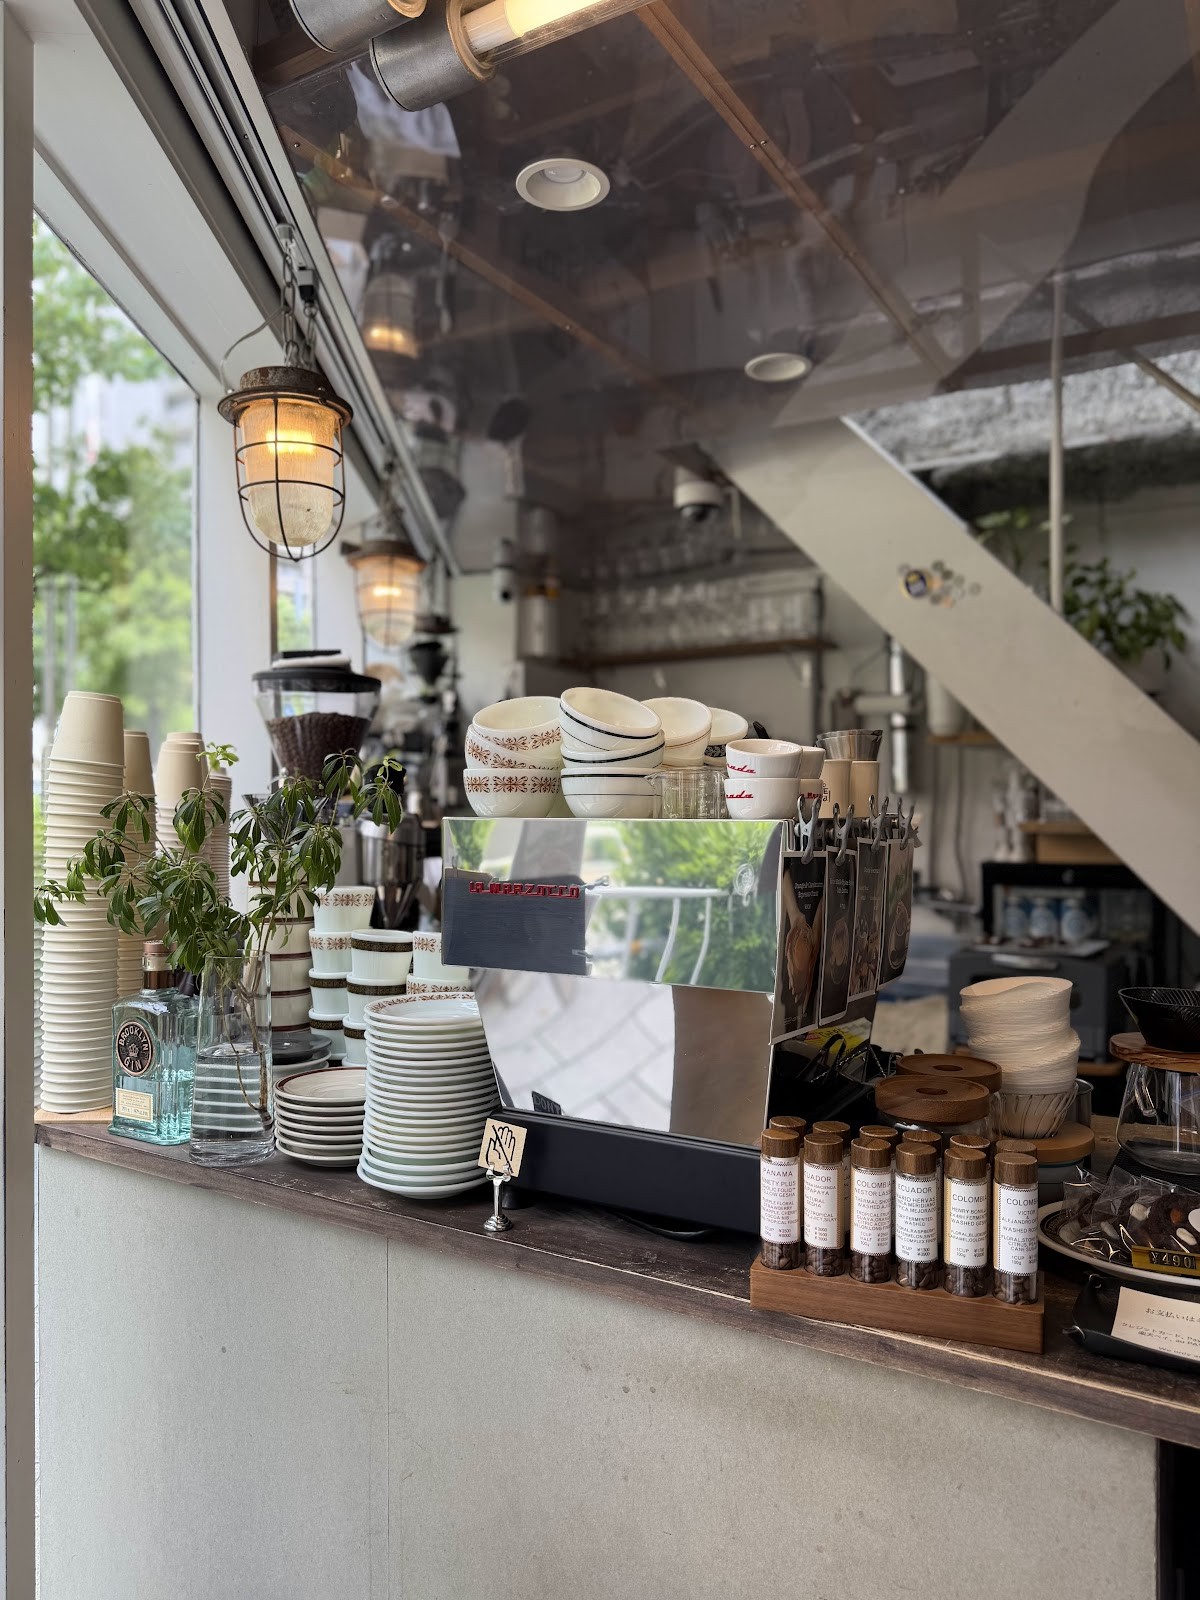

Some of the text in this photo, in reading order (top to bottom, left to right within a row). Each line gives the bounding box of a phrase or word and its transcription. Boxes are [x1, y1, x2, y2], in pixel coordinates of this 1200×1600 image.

[118, 1025, 149, 1052] BROOKLYN
[123, 1056, 142, 1071] GIN
[763, 1167, 793, 1177] PANAMA
[898, 1184, 932, 1194] ECUADOR
[1151, 1251, 1191, 1269] ¥490
